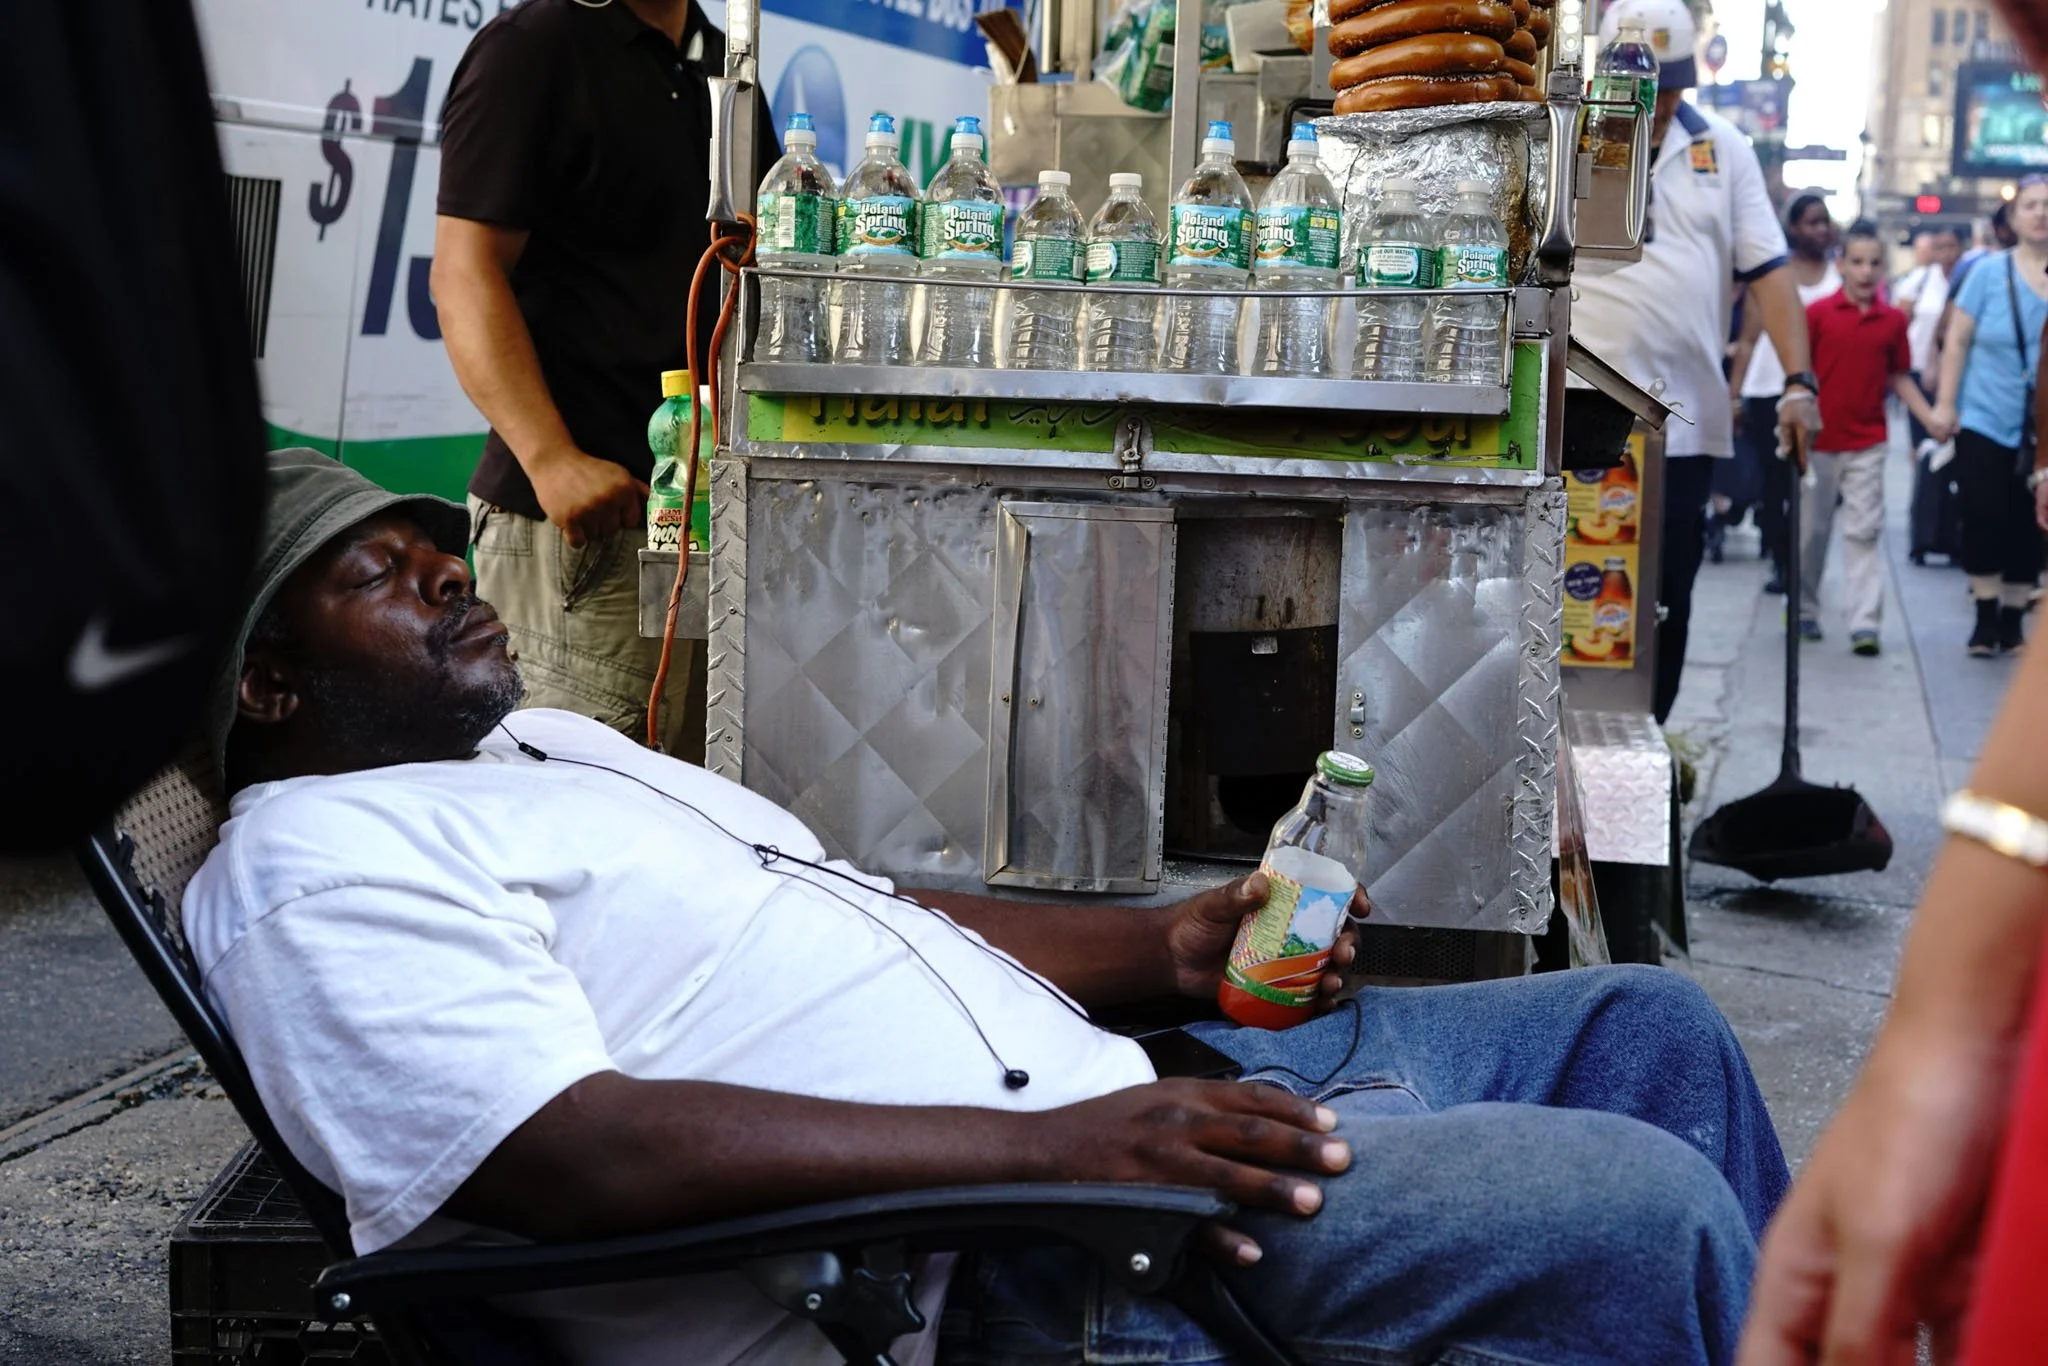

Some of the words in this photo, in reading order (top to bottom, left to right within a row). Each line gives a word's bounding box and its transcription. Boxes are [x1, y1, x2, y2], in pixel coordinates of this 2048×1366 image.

[861, 202, 903, 215] Poland
[950, 205, 992, 220] Poland
[855, 214, 907, 236] Spring
[1182, 211, 1225, 227] Poland
[944, 219, 995, 243] Spring
[1176, 224, 1230, 248] Spring
[1462, 250, 1494, 261] Poland
[1457, 259, 1496, 276] Spring
